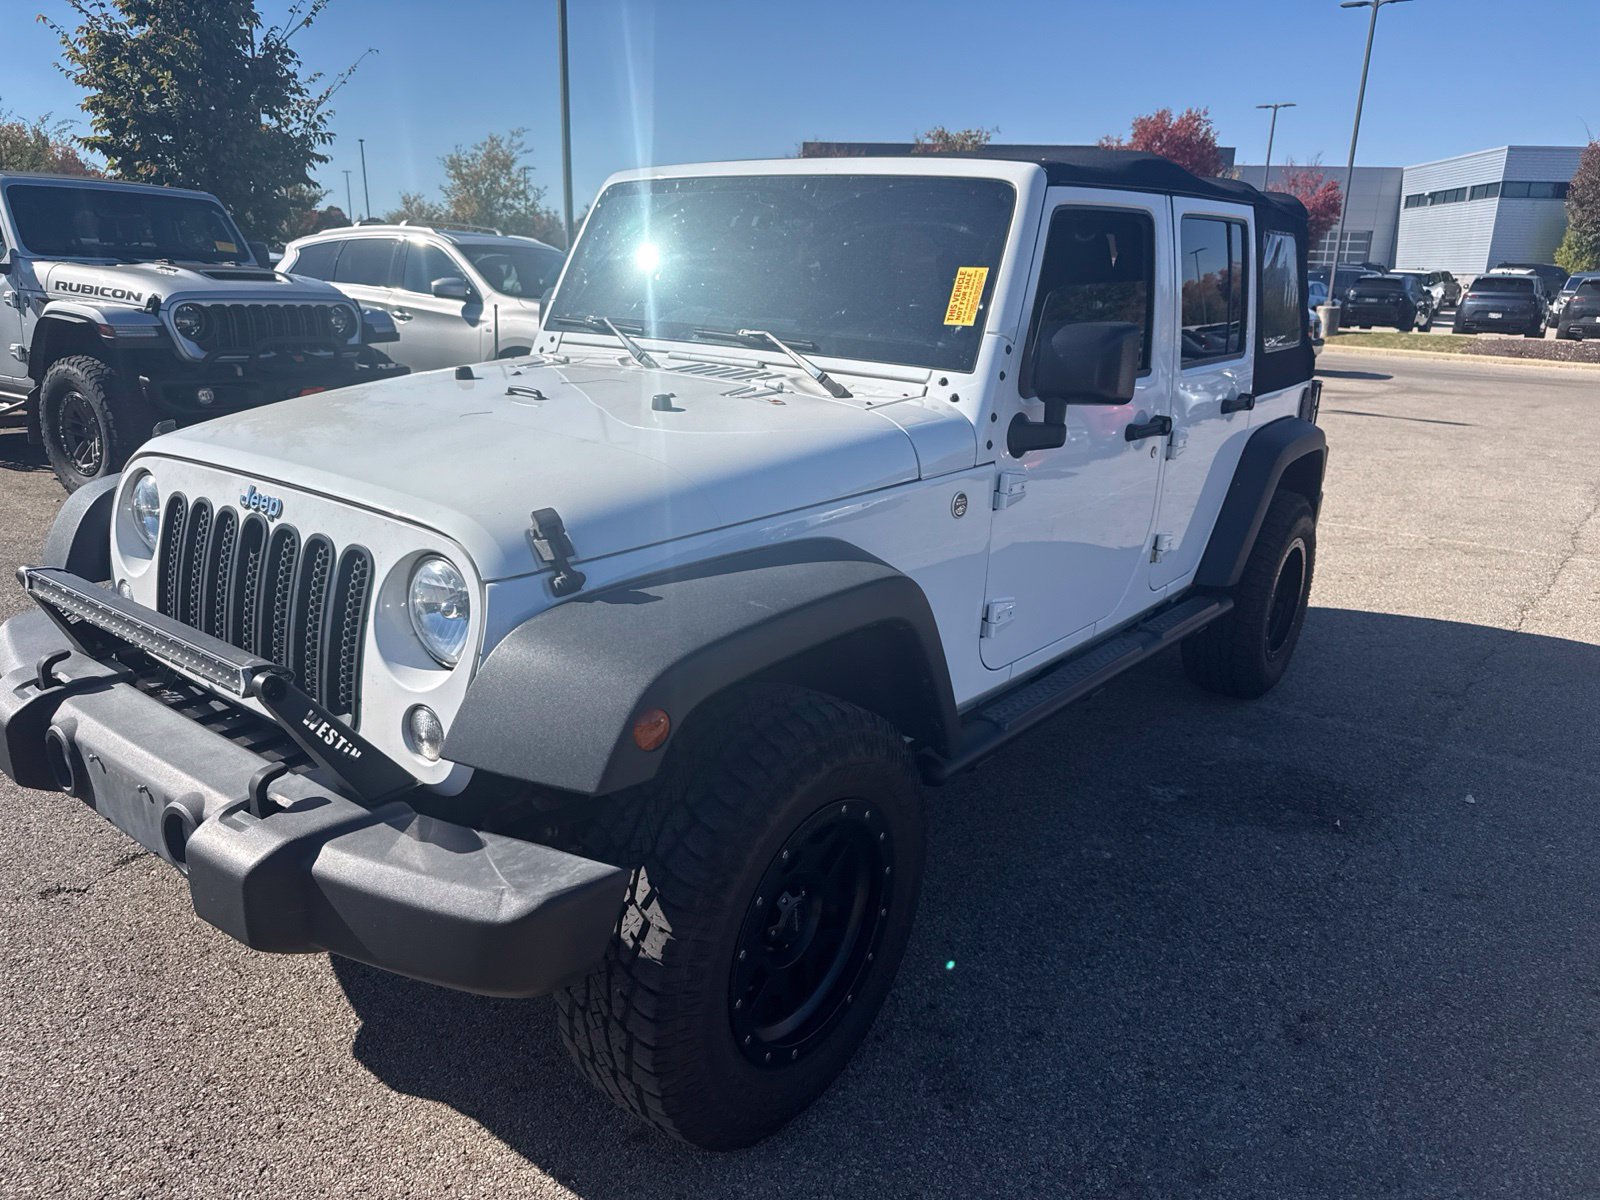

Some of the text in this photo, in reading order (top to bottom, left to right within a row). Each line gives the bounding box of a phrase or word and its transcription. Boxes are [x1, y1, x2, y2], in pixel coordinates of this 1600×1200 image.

[54, 280, 143, 302] RUBICON
[947, 270, 967, 322] THIS VEHICLE
[955, 307, 963, 321] NOT
[959, 291, 968, 305] FOR
[964, 272, 973, 291] SALE
[240, 484, 283, 522] Jeep
